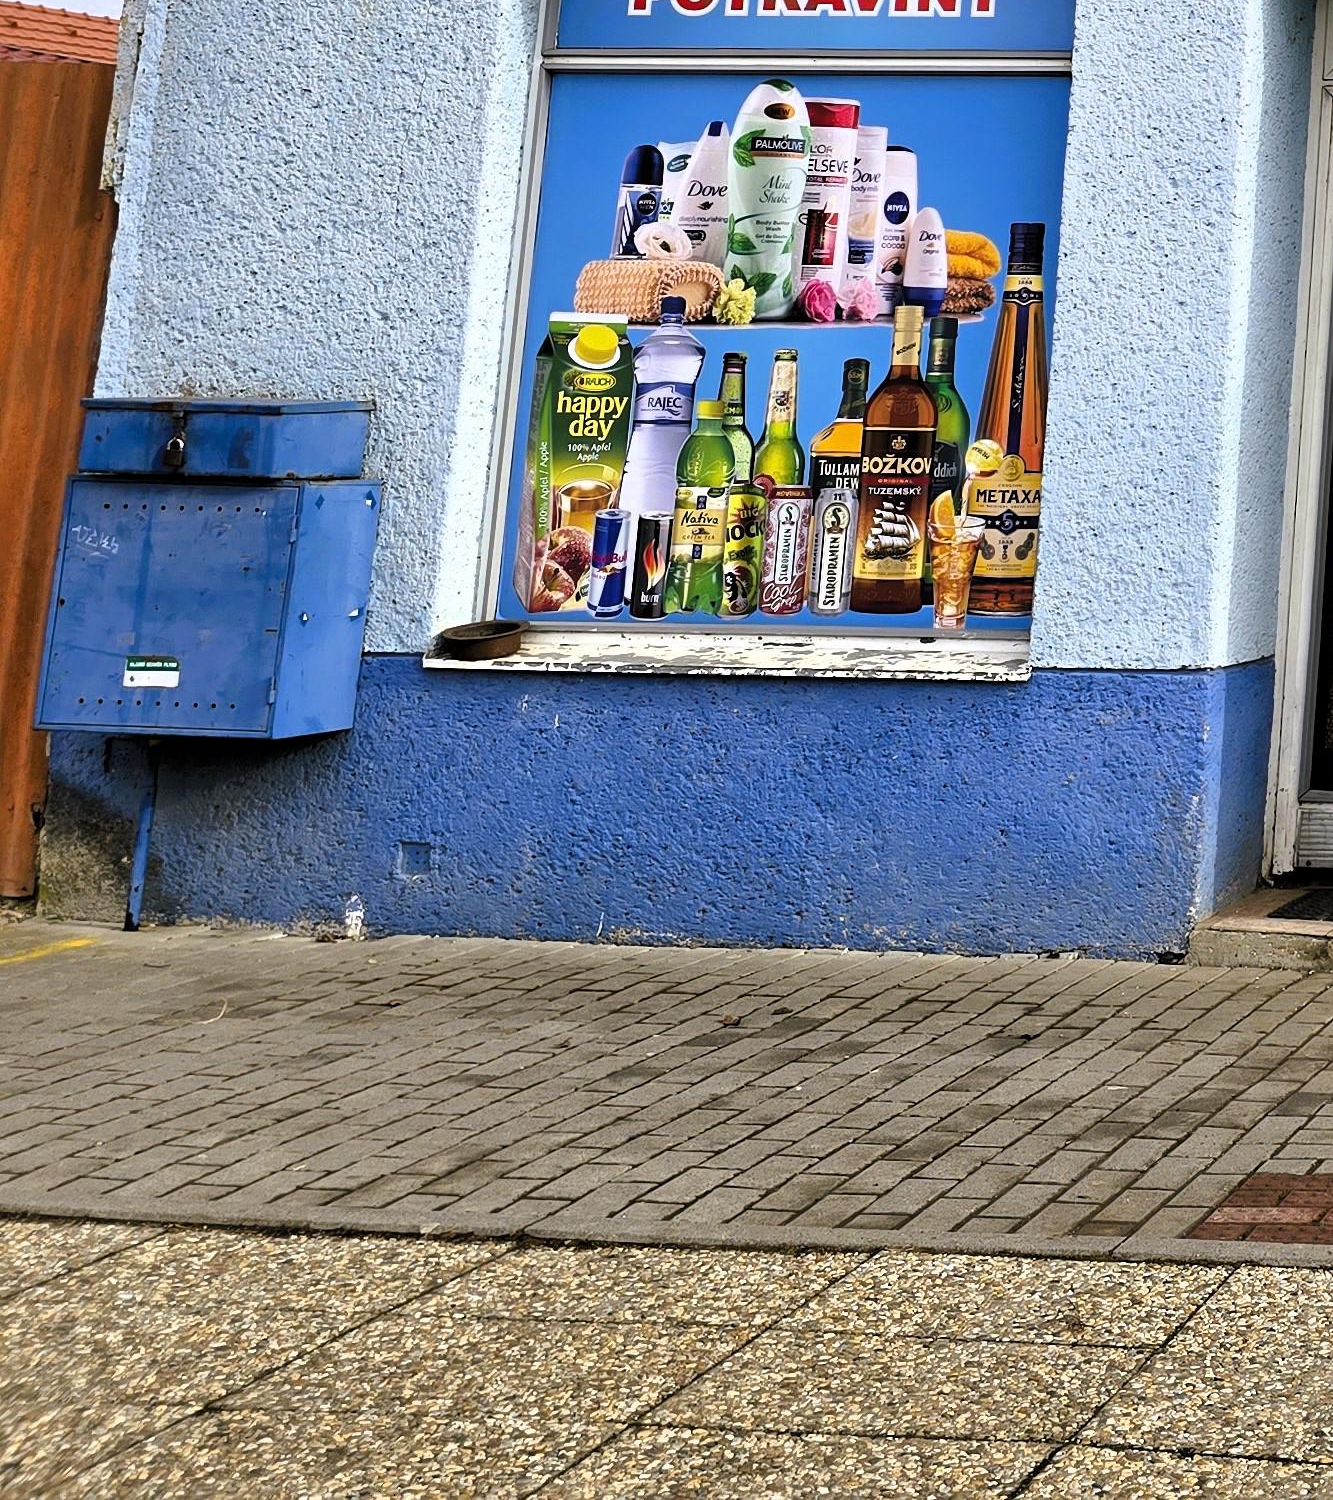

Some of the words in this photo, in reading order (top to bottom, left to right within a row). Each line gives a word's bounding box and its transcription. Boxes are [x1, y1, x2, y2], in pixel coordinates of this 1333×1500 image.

[755, 139, 804, 152] PALMOLIVE
[808, 158, 849, 174] ELSEVE
[762, 174, 792, 190] Mint
[852, 167, 881, 183] Dove
[687, 179, 728, 197] Dove
[851, 185, 866, 194] body
[886, 204, 908, 212] NIVEA
[919, 230, 942, 242] Dove
[585, 377, 611, 386] RAUCH
[556, 390, 629, 420] happy
[647, 396, 683, 411] RAJEC
[568, 413, 615, 441] day
[539, 441, 549, 467] Apple
[567, 443, 589, 452] 100%
[591, 442, 611, 452] Apfel
[576, 452, 600, 462] Apple
[862, 453, 933, 475] BOŽKOV
[818, 460, 860, 476] TULLAM
[538, 474, 549, 502] Apfel
[836, 477, 859, 489] DEW
[868, 486, 922, 496] TUZEMSKÝ
[975, 489, 1041, 504] METAXA
[538, 502, 549, 528] 100%
[740, 508, 759, 519] BIG
[1000, 512, 1014, 531] 5
[778, 528, 792, 582] STAROPRAMEN
[822, 536, 841, 607] STAROPRAMEN
[762, 574, 804, 603] Cool
[640, 591, 660, 603] burn
